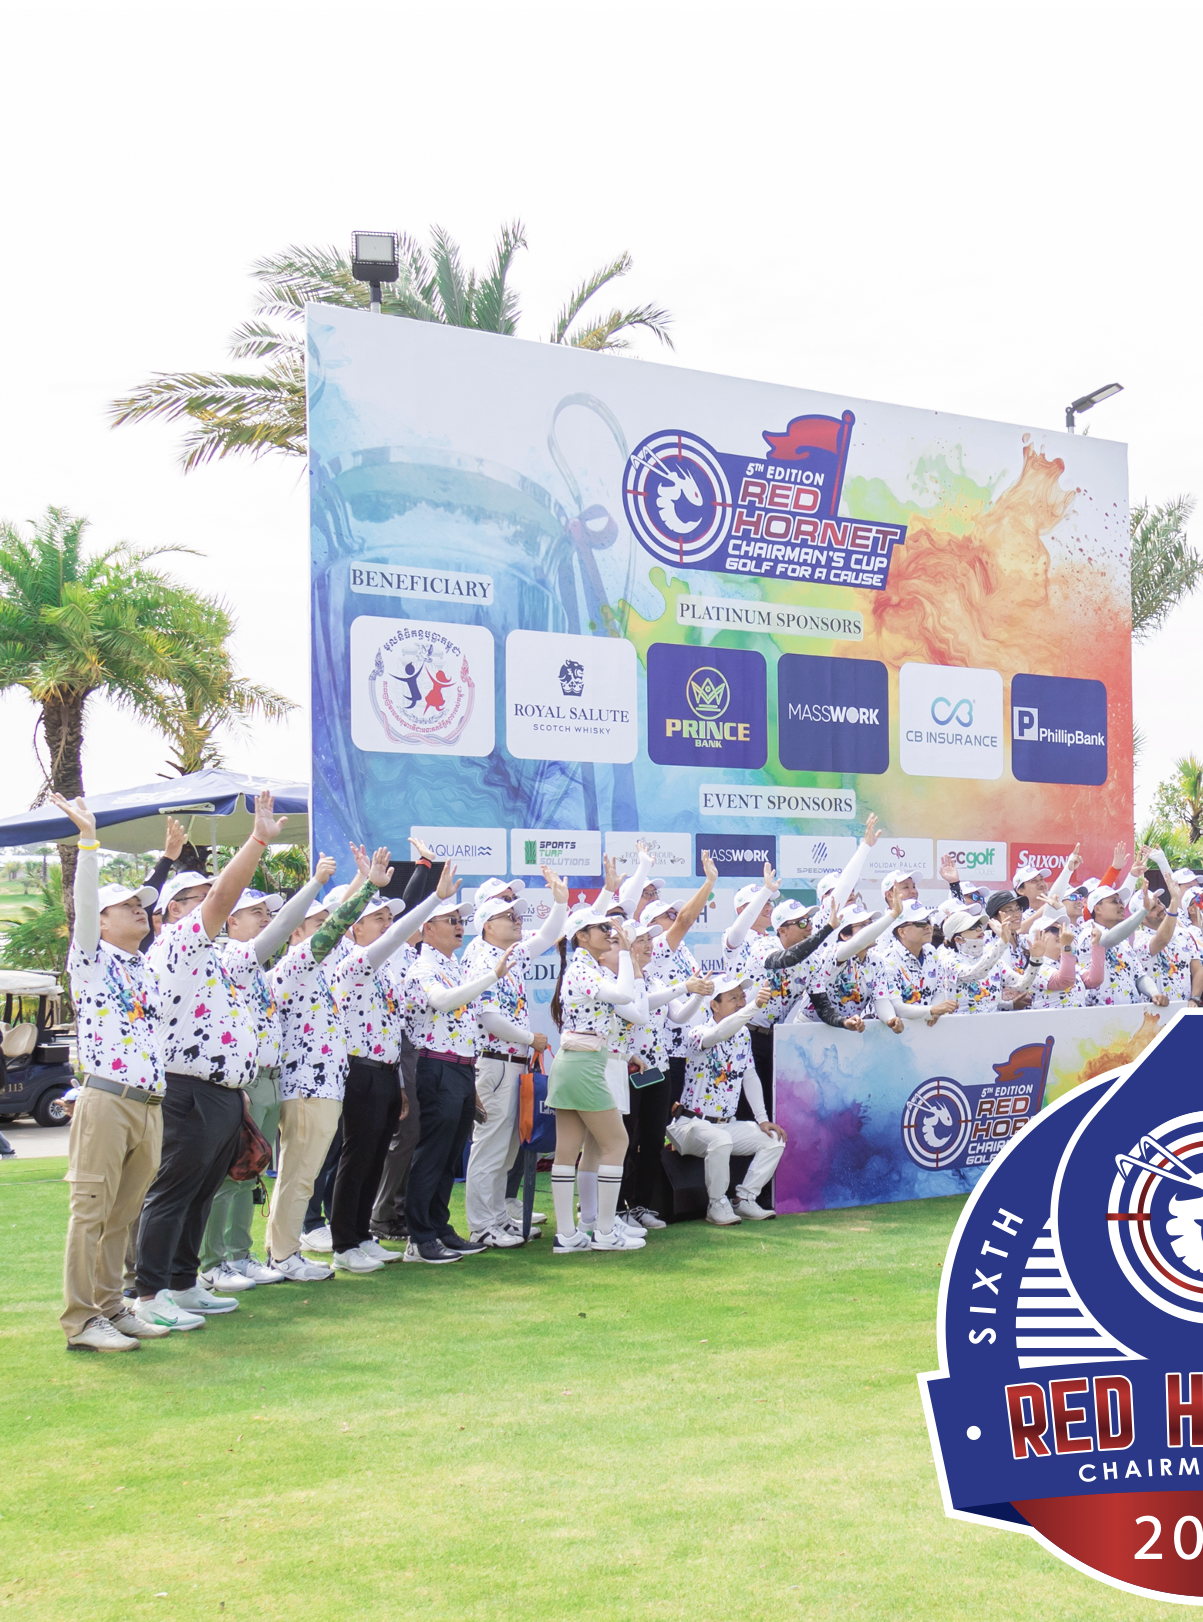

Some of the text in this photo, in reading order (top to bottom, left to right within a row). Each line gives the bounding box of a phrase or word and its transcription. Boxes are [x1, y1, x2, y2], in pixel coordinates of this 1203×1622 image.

[746, 463, 825, 486] 5TH EDITION
[738, 477, 821, 514] RED
[731, 509, 900, 554] HORNET
[728, 539, 888, 572] CHAIRMAN'S CUP
[725, 557, 884, 587] GOLF FOR A CAUSE
[351, 568, 491, 598] BENEFICIARY
[680, 602, 862, 634] PLATINUM SPONSORS
[513, 703, 630, 723] ROYAL SALUTE
[788, 702, 880, 725] MASSWORK
[533, 724, 611, 735] SCOTCH WHISKY
[666, 718, 750, 741] PRINCE
[906, 731, 998, 748] CB INSURANCE
[1039, 727, 1105, 747] PhillipBank
[695, 739, 722, 748] BANK
[703, 793, 853, 812] EVENT SPONSORS
[539, 841, 576, 849] SPORTS
[539, 849, 563, 857] TURF
[539, 857, 590, 866] SOLUTIONS
[8, 1083, 24, 1092] 113
[981, 1084, 1033, 1098] 5TH EDITION
[975, 1095, 1031, 1119] RED
